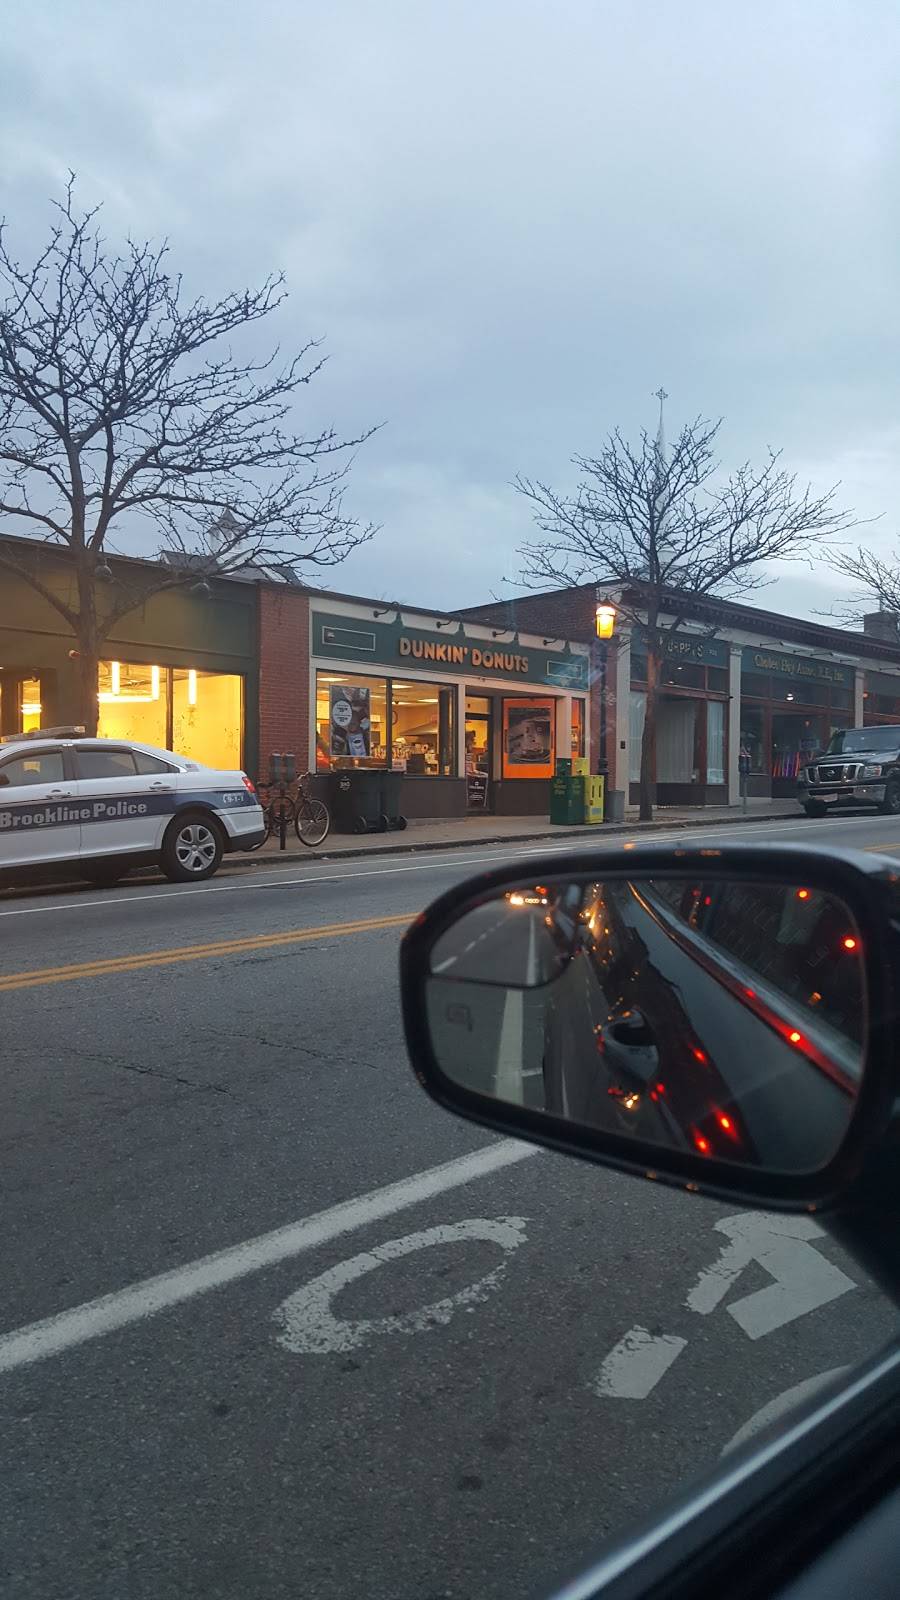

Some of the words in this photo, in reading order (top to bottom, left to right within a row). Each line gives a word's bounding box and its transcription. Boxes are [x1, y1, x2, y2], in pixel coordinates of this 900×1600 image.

[399, 637, 468, 664] DUNKIN'
[471, 648, 529, 673] DONUTS
[0, 806, 91, 828] Brookline
[93, 801, 148, 817] Police
